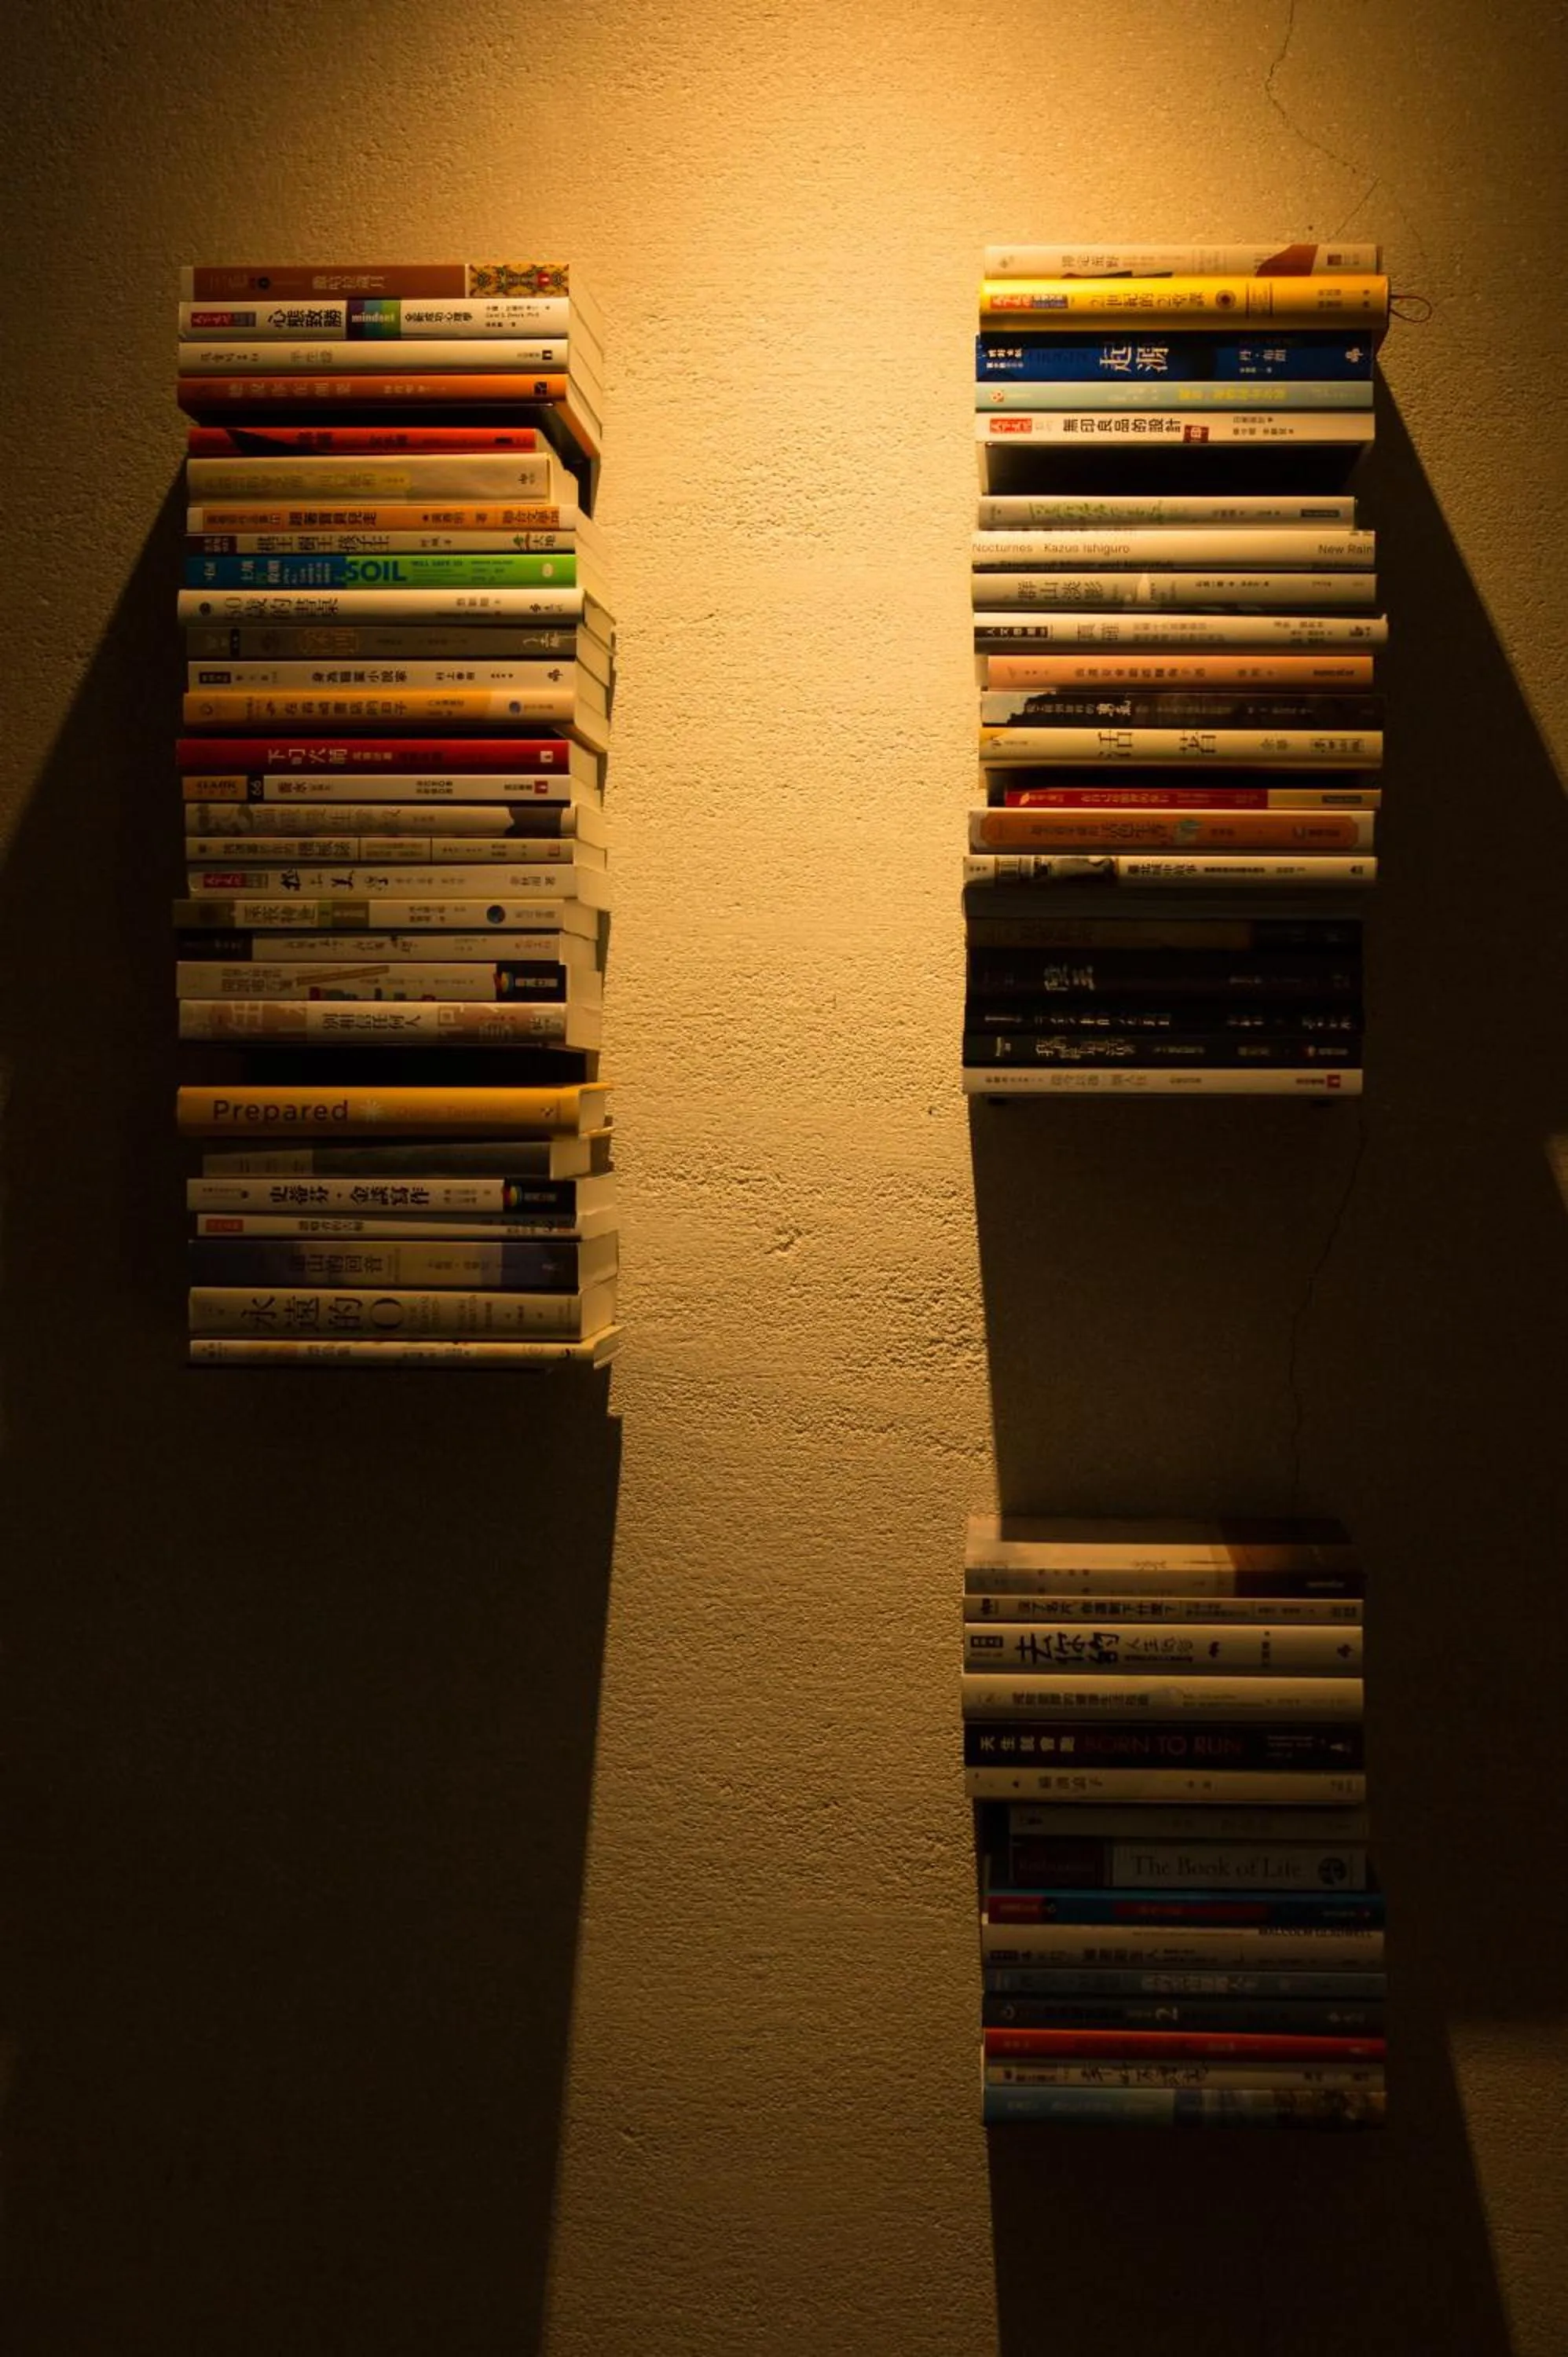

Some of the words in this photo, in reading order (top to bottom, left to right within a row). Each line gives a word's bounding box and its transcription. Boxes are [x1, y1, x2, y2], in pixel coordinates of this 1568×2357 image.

[267, 310, 343, 327] 心態致勝
[351, 311, 395, 322] mindset
[1099, 344, 1170, 372] 起源
[1062, 419, 1181, 433] 無印良品的設計
[256, 534, 390, 552] 棋王樹王孩子王
[971, 543, 1034, 553] Nocturnes
[1043, 543, 1079, 553] Kazuo
[1083, 543, 1131, 555] Ishiguro
[1317, 544, 1345, 555] New
[346, 561, 407, 582] SOIL
[434, 671, 474, 681] 村上春樹
[267, 747, 348, 765] 下町火箭
[248, 779, 262, 797] 66
[321, 1013, 421, 1030] 別相信任何人
[212, 1099, 349, 1121] Prepared
[1015, 1633, 1120, 1666] 去你的
[979, 1735, 1075, 1753] 天生就會跑
[1155, 1735, 1188, 1755] TO
[1130, 1855, 1171, 1876] The
[1178, 1855, 1231, 1876] Book
[1236, 1855, 1259, 1876] of
[1262, 1856, 1307, 1877] Life
